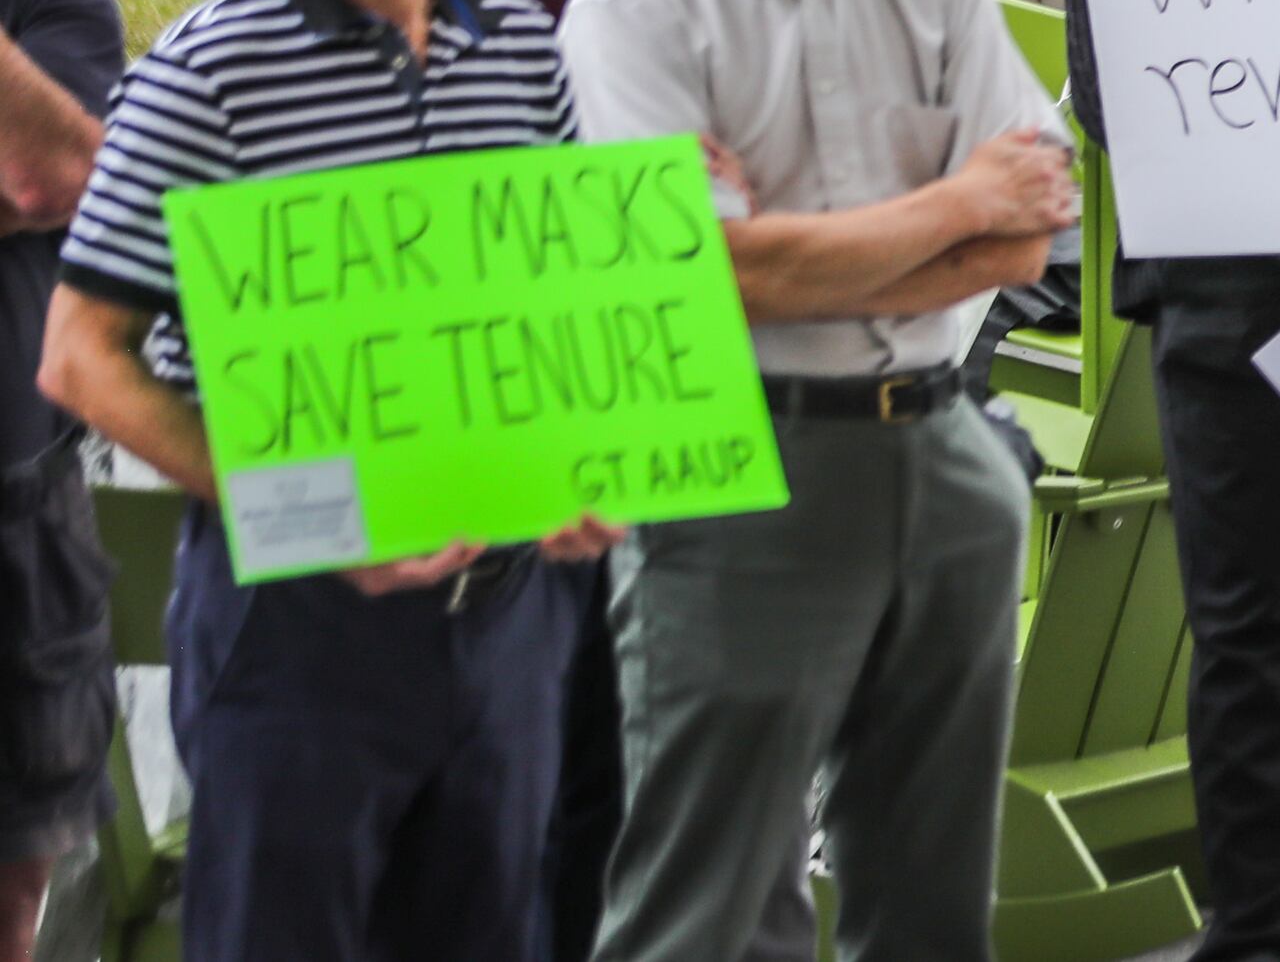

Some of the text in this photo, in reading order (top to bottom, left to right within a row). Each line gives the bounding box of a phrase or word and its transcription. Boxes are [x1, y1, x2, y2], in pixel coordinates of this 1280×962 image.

[188, 162, 704, 313] WEAR MASKS
[223, 298, 716, 456] SAVE TENURE
[571, 435, 756, 503] GT AAUP
